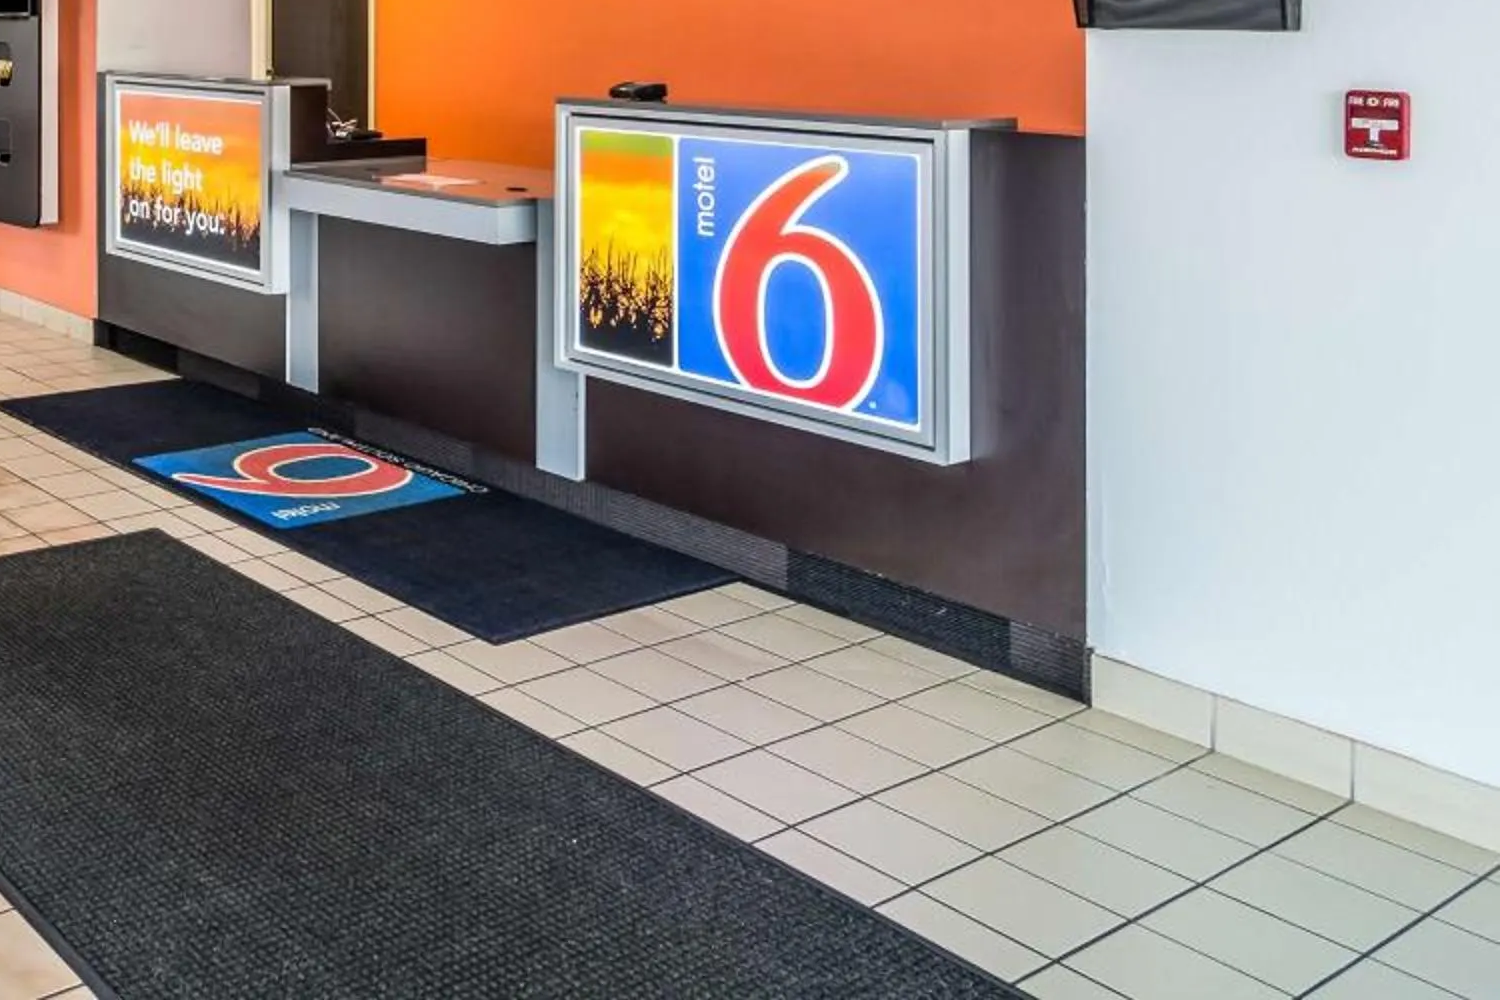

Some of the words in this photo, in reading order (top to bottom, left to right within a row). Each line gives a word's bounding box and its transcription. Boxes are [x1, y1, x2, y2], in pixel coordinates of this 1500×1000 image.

[129, 120, 170, 148] We'll
[175, 125, 224, 155] leave
[130, 156, 156, 183] the
[162, 161, 204, 195] light
[129, 199, 150, 219] on
[155, 196, 183, 225] for
[185, 211, 226, 235] you.
[692, 156, 715, 237] motel
[713, 153, 884, 412] 6
